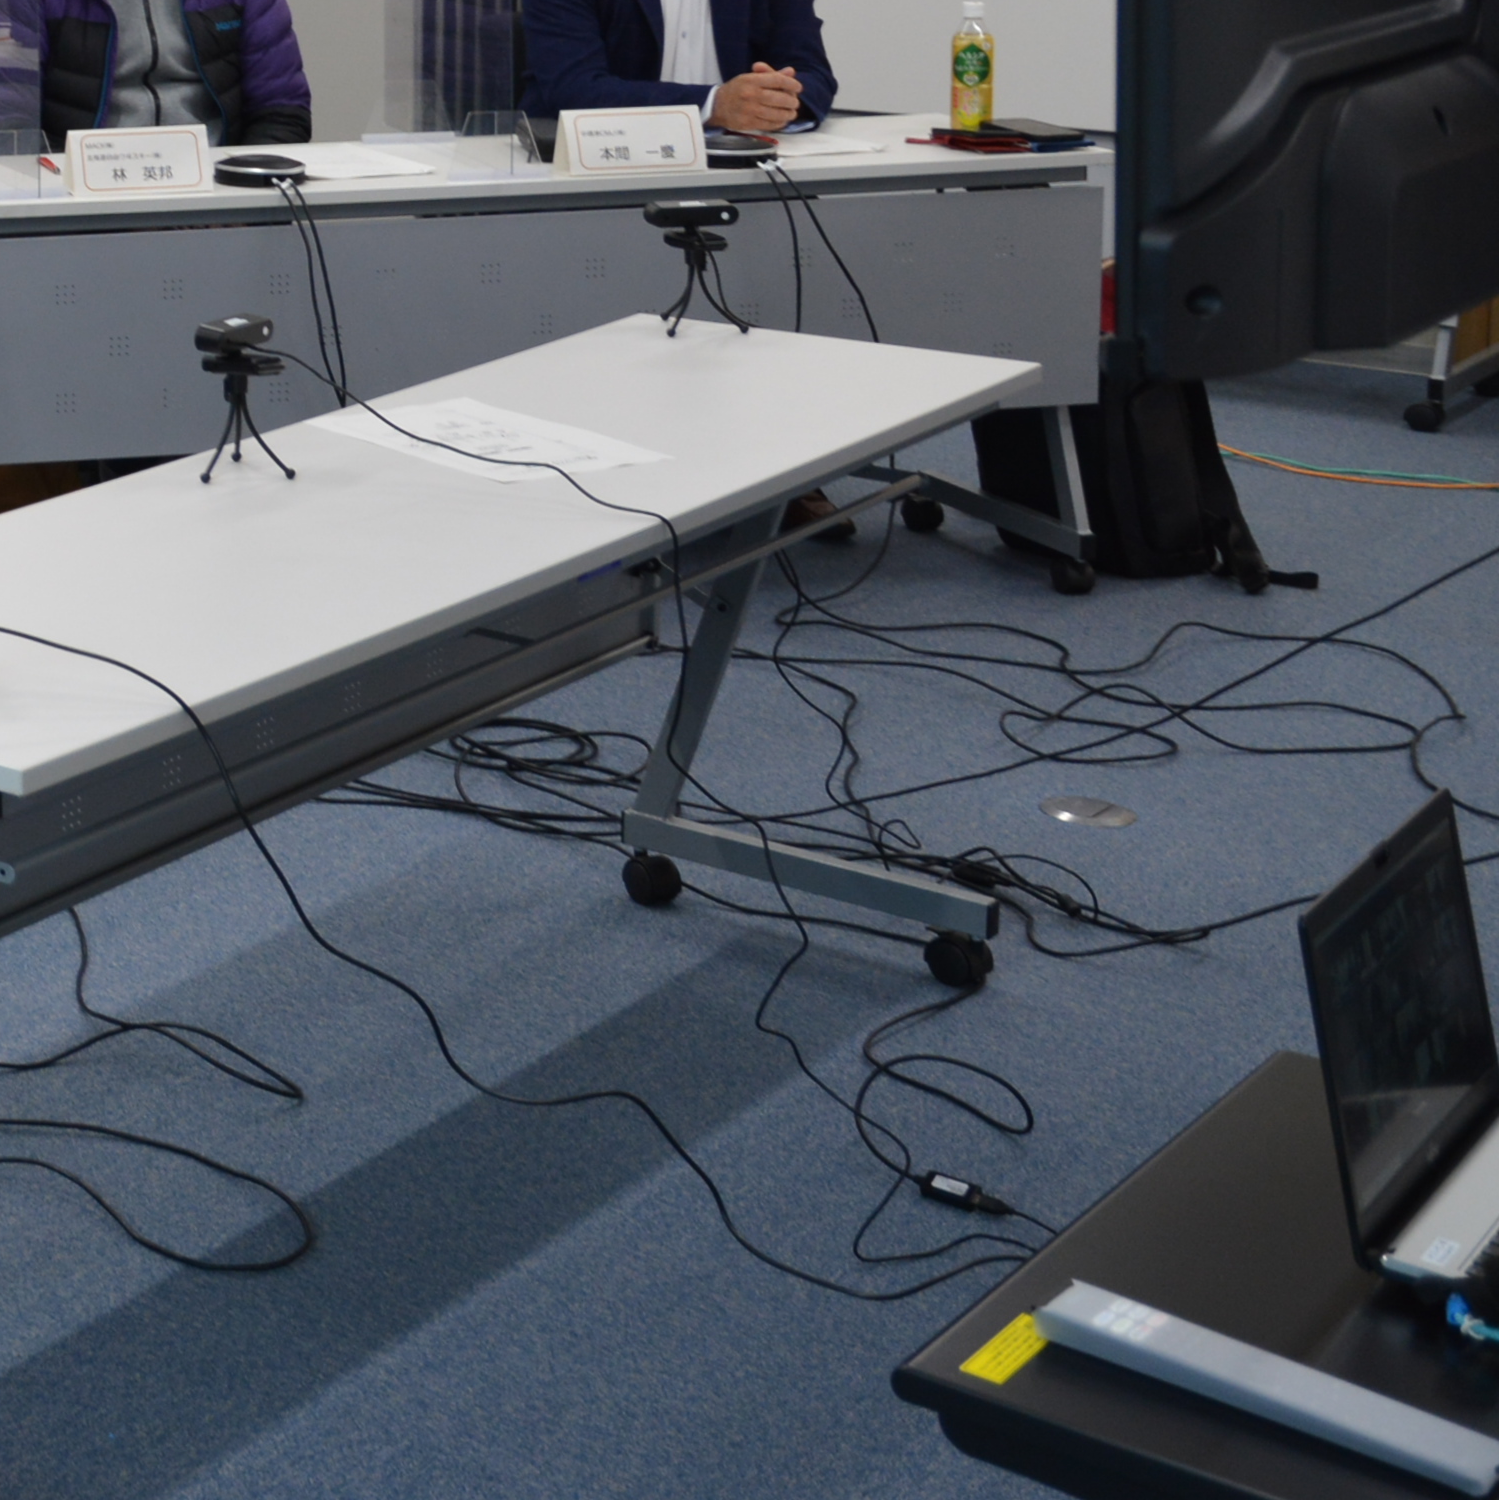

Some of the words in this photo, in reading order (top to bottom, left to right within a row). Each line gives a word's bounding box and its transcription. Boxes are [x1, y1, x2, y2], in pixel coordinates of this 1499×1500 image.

[599, 145, 630, 161] 本間
[112, 167, 128, 182] 林
[142, 165, 174, 182] 英邦
